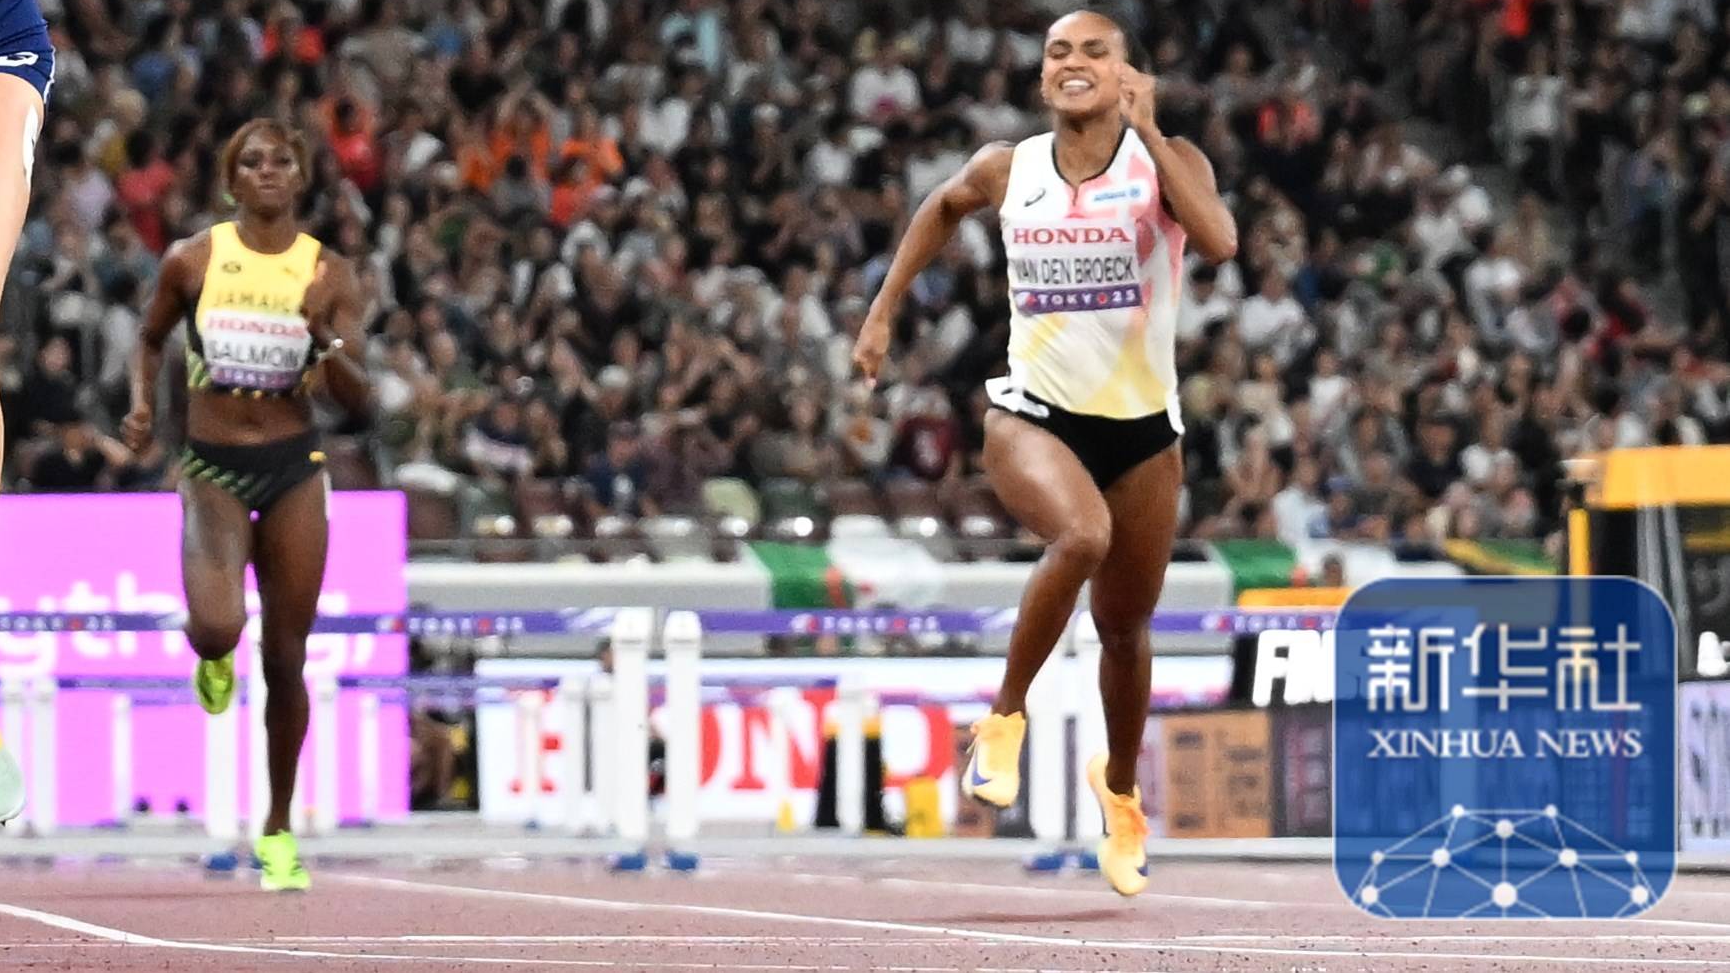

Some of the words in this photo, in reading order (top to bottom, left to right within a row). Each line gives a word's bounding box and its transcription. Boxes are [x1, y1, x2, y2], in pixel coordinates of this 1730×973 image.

[1013, 227, 1132, 245] HONDA
[1041, 257, 1071, 284] DEN
[1074, 255, 1135, 284] BROECK
